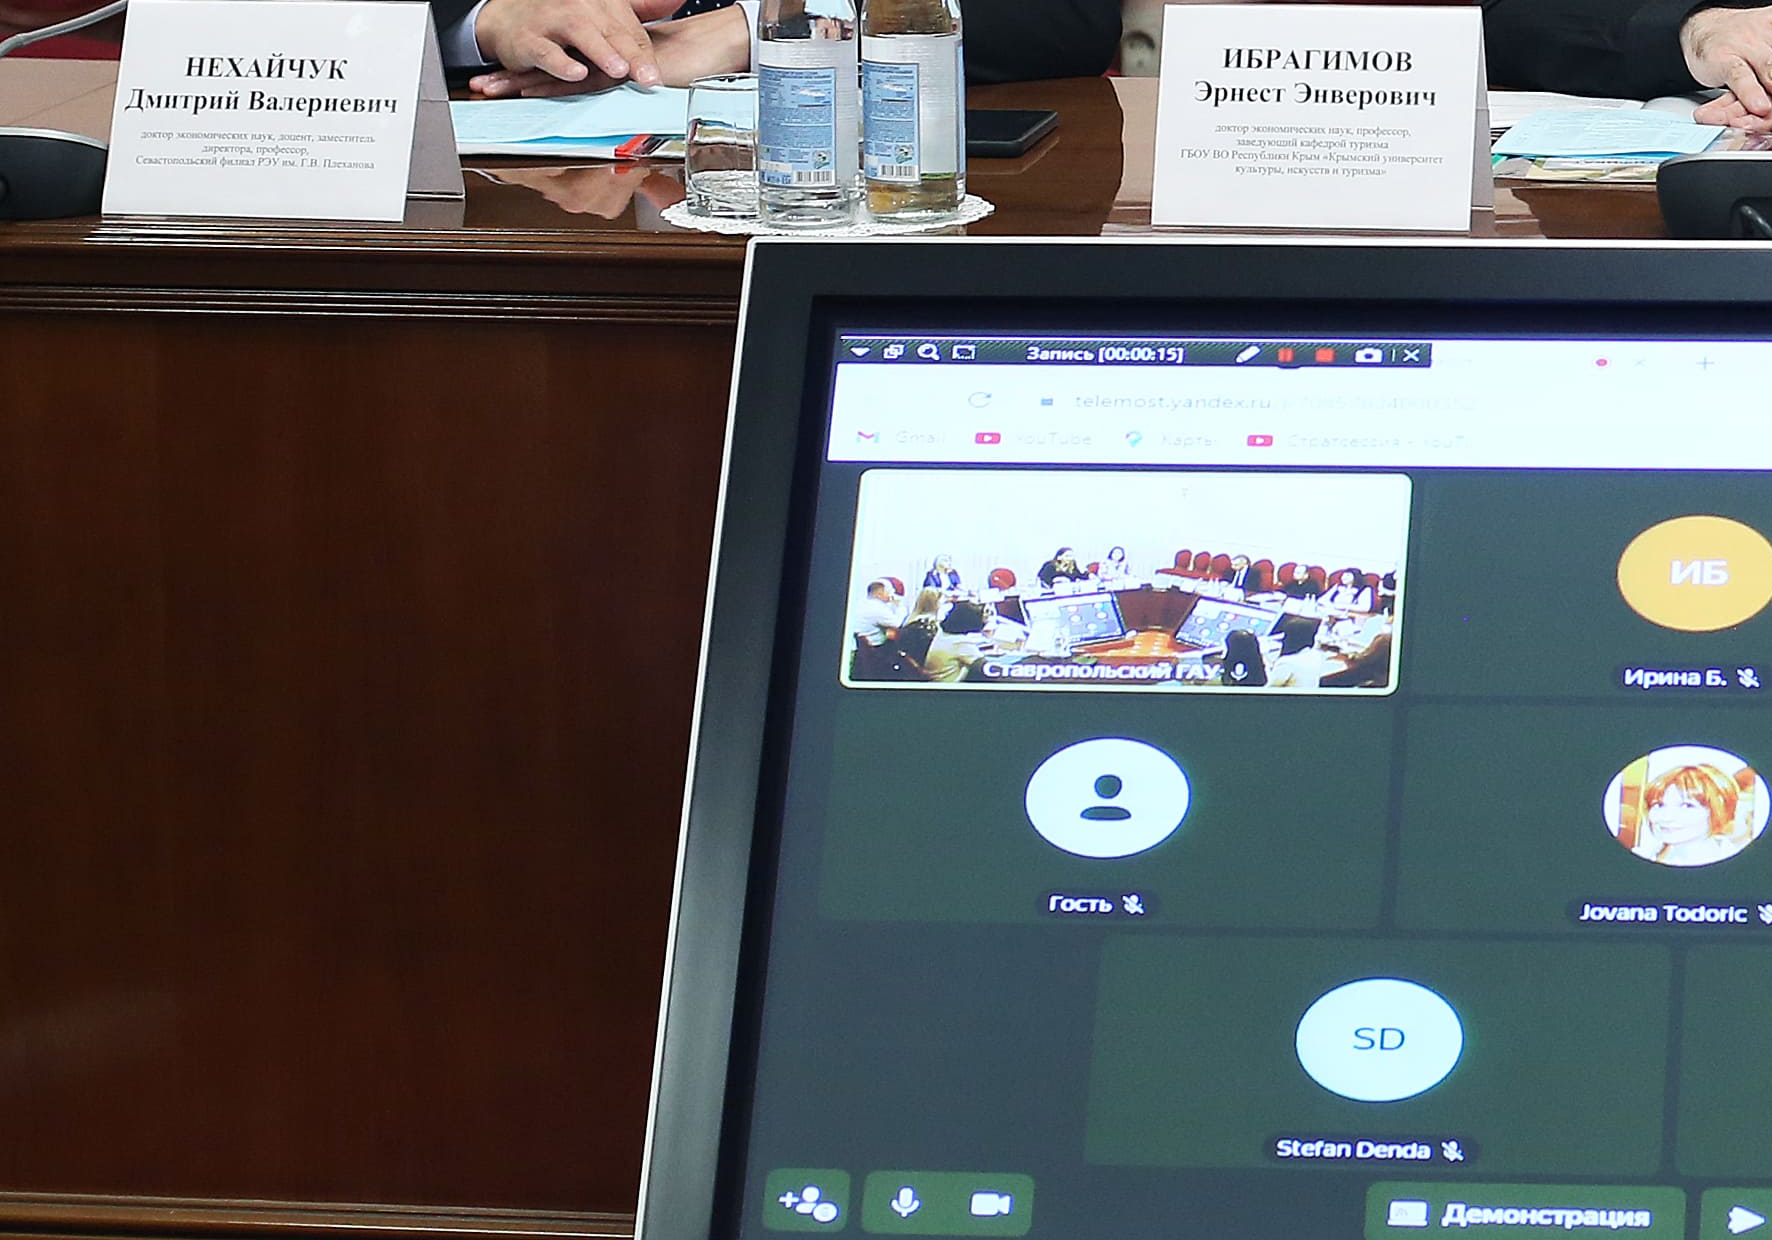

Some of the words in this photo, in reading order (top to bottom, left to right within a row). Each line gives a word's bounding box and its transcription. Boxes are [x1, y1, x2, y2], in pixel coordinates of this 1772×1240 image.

[186, 53, 347, 79] НЕХАЙЧУК
[1224, 49, 1412, 71] ИБРАГИМОВ
[125, 89, 239, 115] Дмитрий
[249, 91, 396, 117] Валериевич
[1196, 81, 1285, 107] Эрнест
[1295, 83, 1435, 110] Энверович
[1026, 346, 1095, 362] Запись
[1098, 346, 1185, 364] [00:00:15]
[1670, 559, 1730, 586] ИБ
[983, 661, 1173, 682] Ставропольский
[1177, 663, 1219, 681] ГАУ
[1625, 669, 1701, 688] Ирина
[1706, 670, 1727, 686] Б.
[1049, 896, 1112, 912] Гость
[1580, 904, 1657, 921] Jovana
[1663, 905, 1748, 922] Todoric
[1352, 1027, 1406, 1051] SD
[1277, 1140, 1351, 1157] Stefan
[1356, 1141, 1431, 1159] Denda
[1442, 1204, 1650, 1229] Демонстрация
